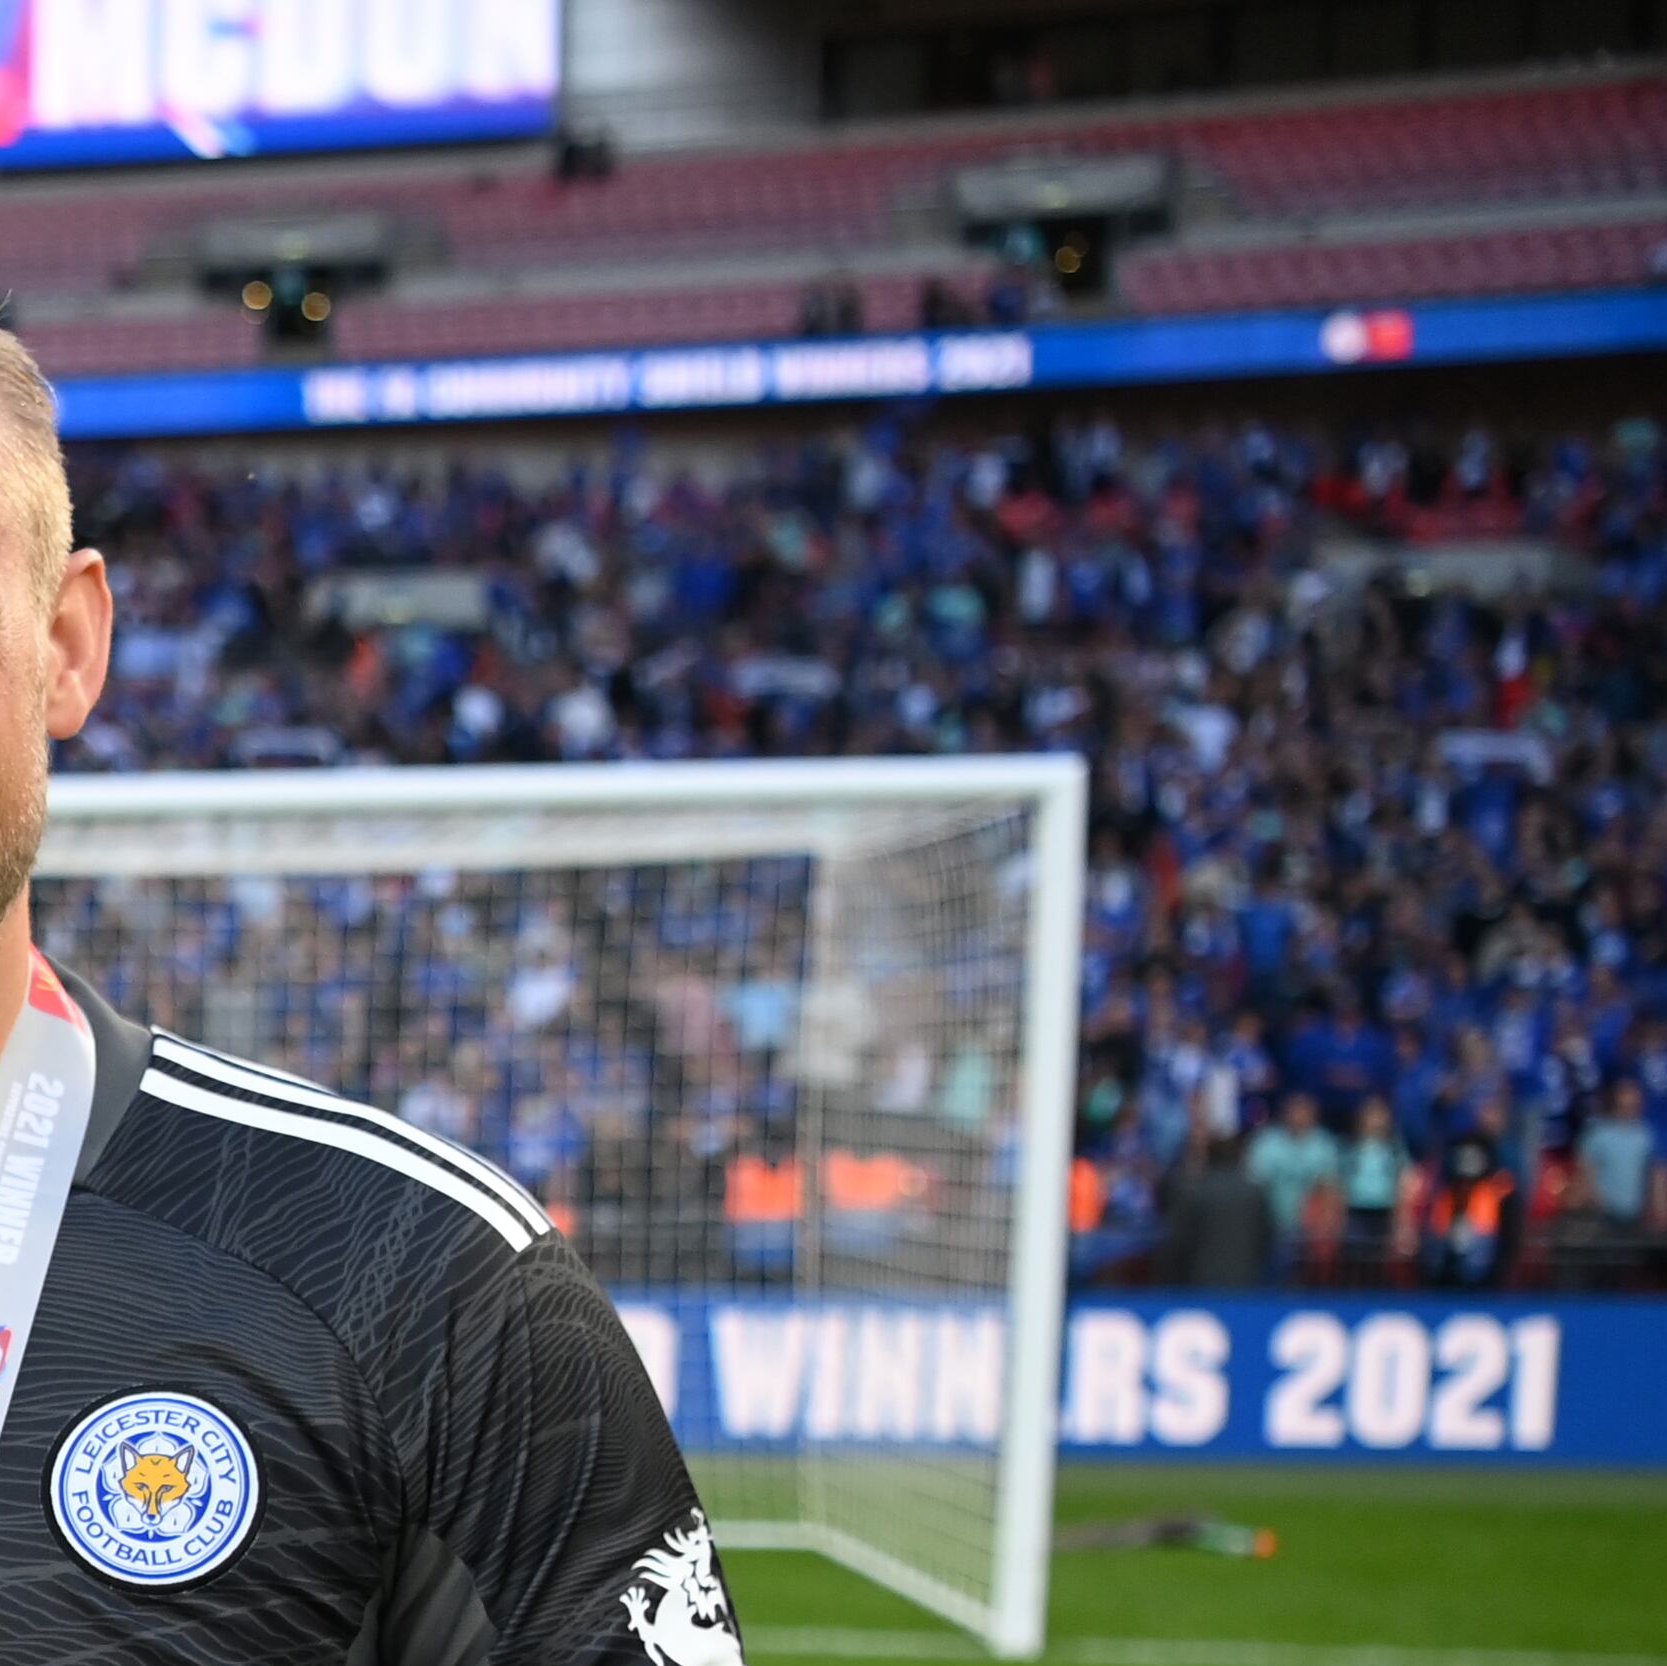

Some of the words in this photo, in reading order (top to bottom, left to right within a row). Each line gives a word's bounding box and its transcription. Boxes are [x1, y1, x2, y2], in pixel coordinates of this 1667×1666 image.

[12, 1071, 64, 1146] 2021
[711, 1307, 1231, 1447] WINNRS
[1266, 1310, 1557, 1450] 2021
[75, 1409, 201, 1475] LEICESTER
[201, 1430, 237, 1485] CITY
[72, 1489, 182, 1567] FOOTBALL
[184, 1499, 235, 1557] CLUB
